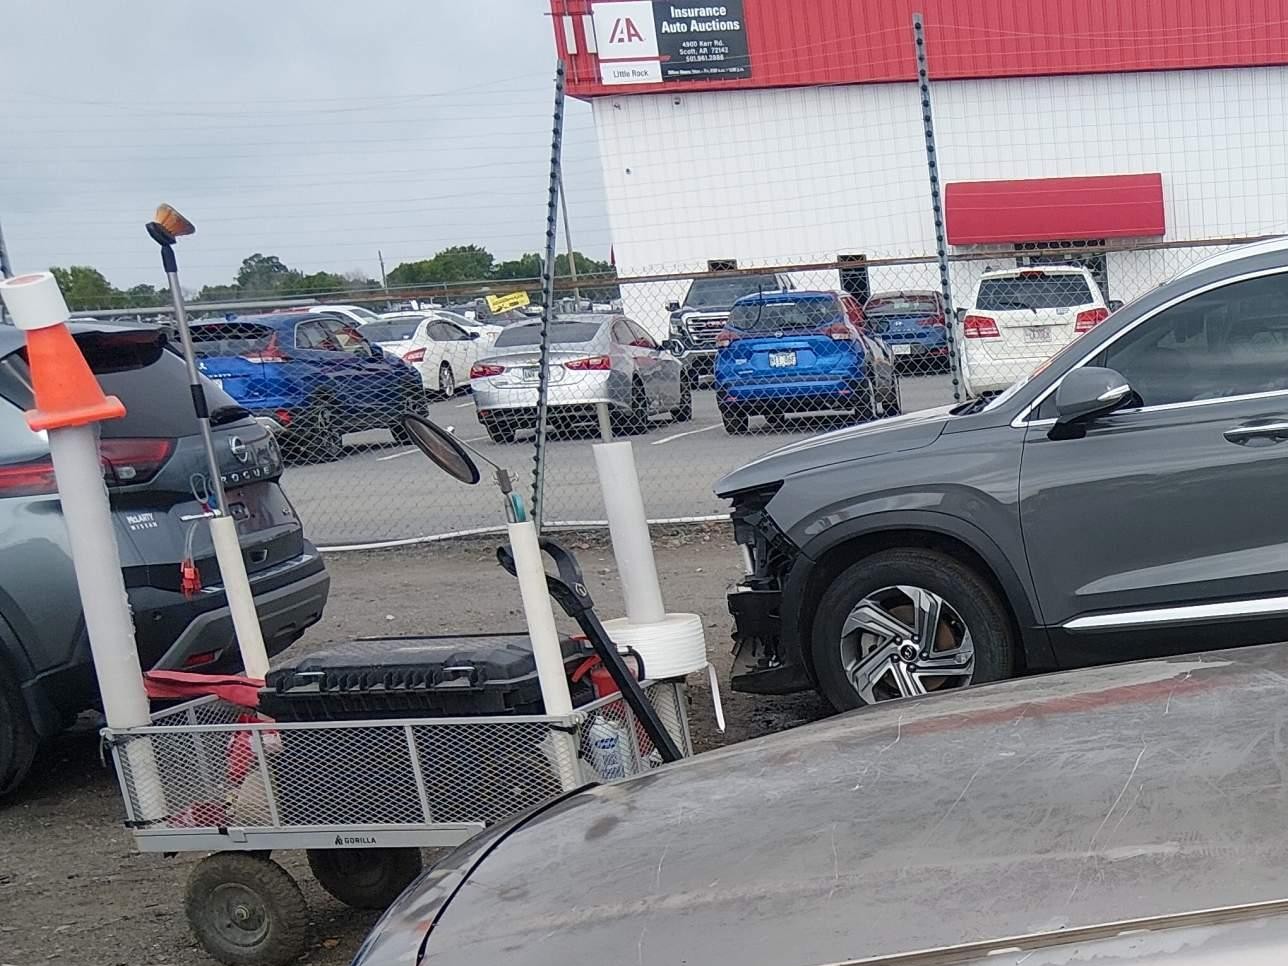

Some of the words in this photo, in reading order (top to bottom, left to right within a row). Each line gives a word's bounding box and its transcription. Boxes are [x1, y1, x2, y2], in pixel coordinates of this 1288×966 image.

[670, 6, 727, 18] Insurance
[661, 21, 688, 33] Auto
[690, 19, 740, 32] Auctions
[679, 48, 698, 56] Scott,
[613, 70, 631, 78] Little
[631, 69, 649, 77] Rock
[220, 467, 271, 484] ROGUE
[344, 836, 377, 844] GORILLA
